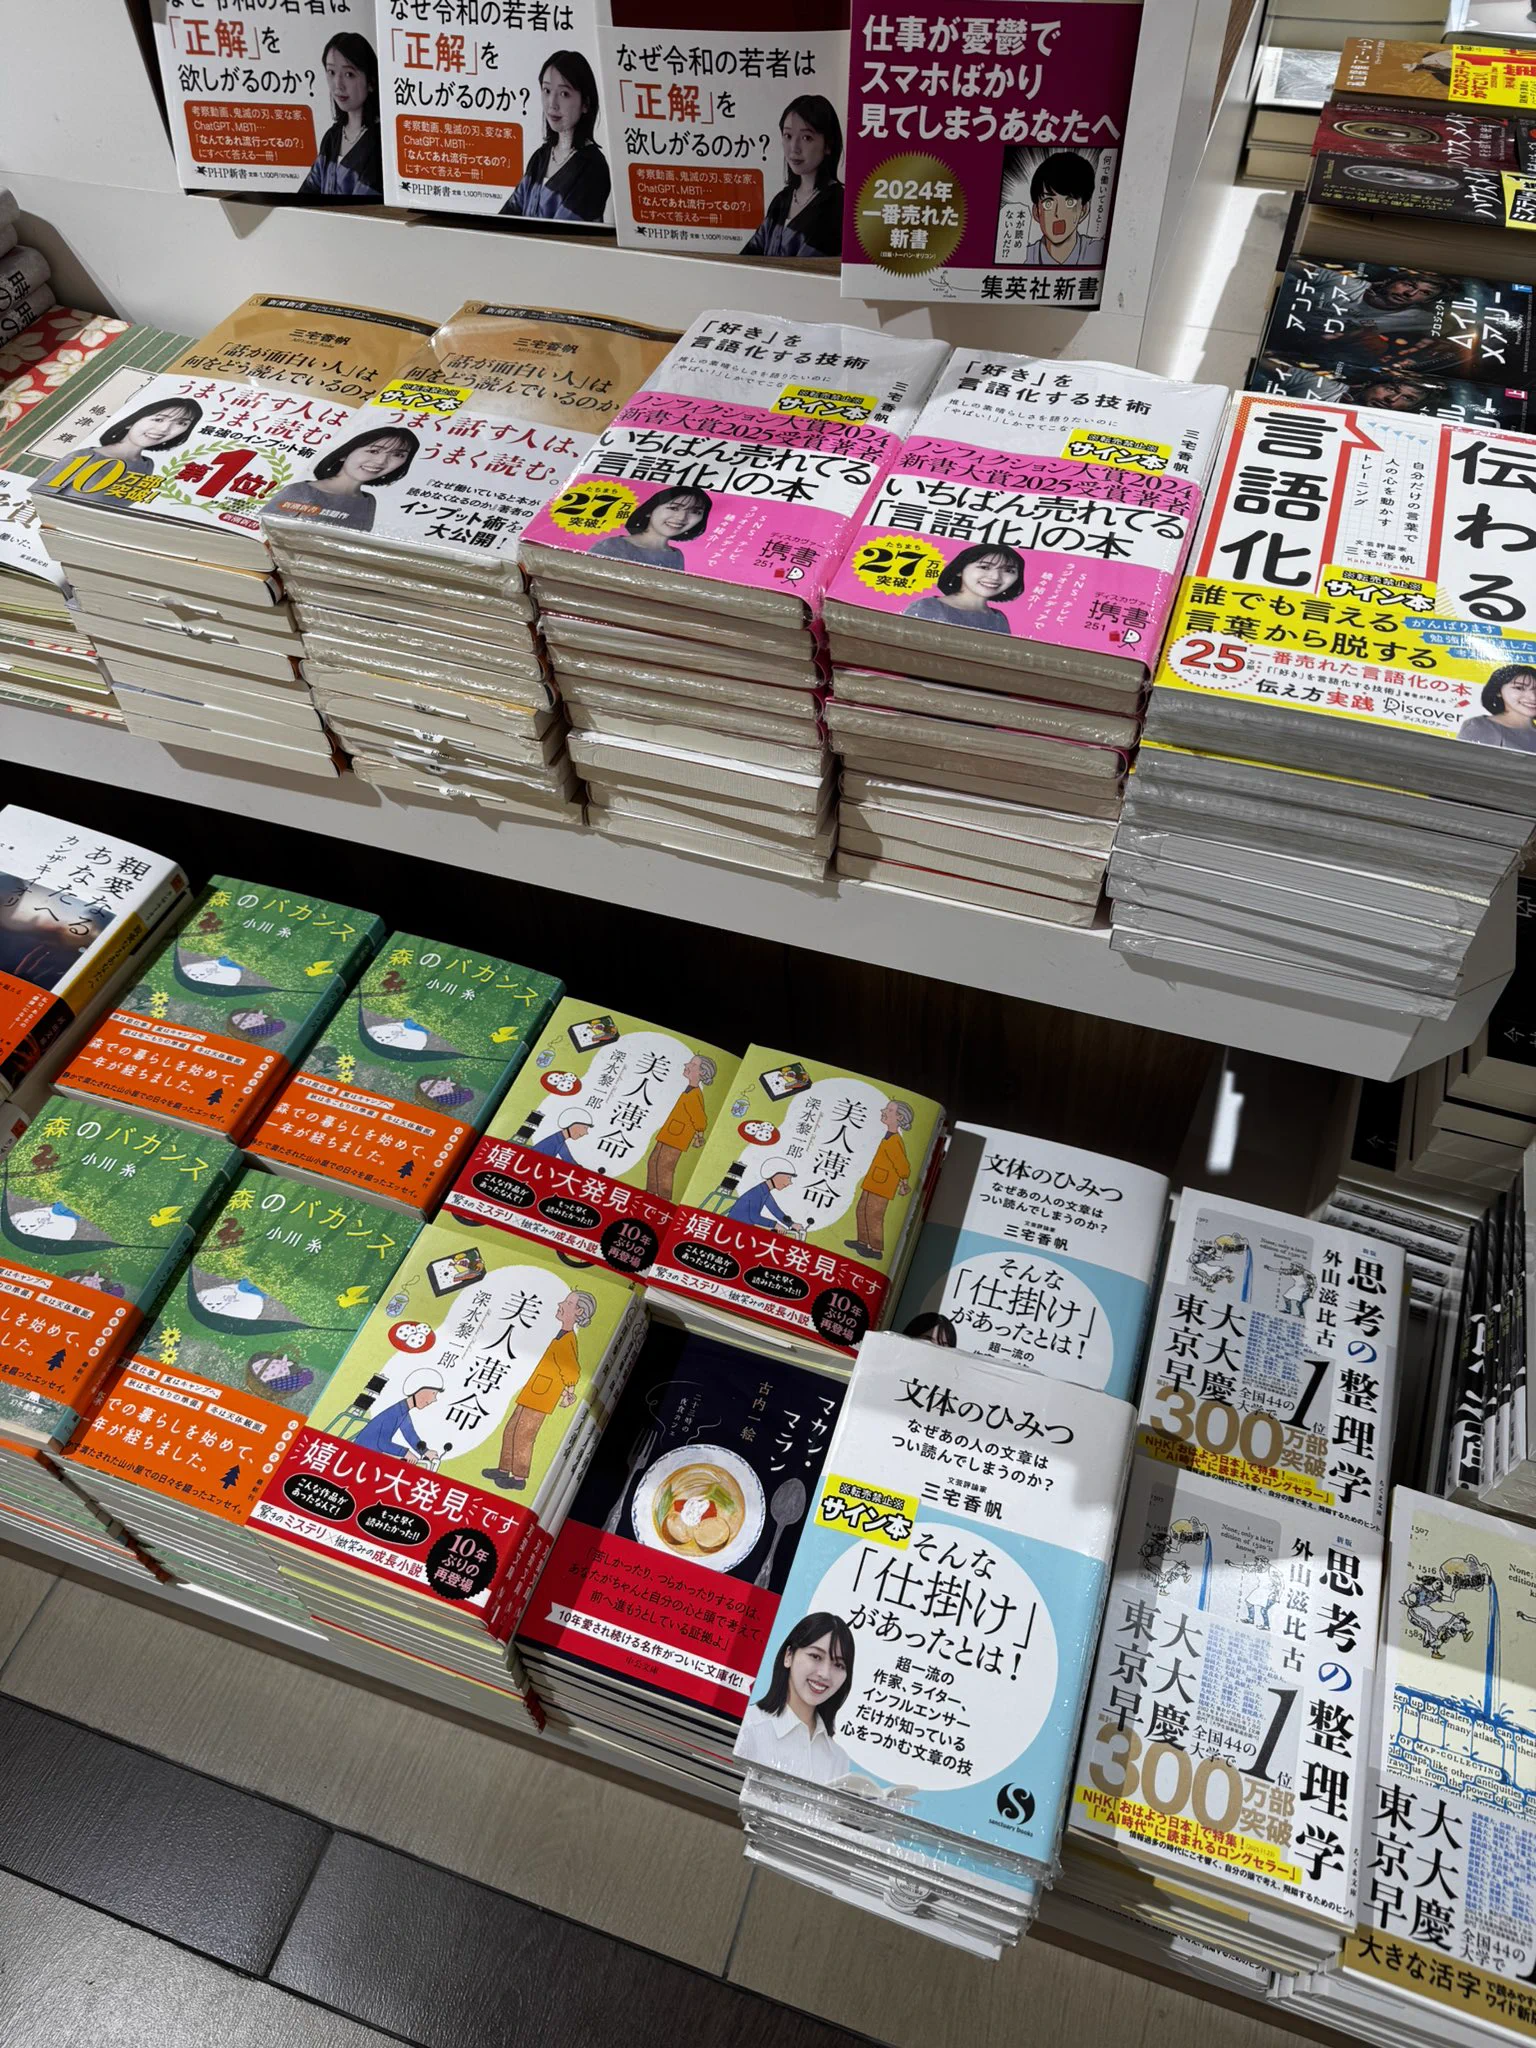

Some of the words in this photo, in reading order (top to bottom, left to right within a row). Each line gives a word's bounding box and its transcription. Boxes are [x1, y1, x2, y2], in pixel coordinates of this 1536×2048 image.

[169, 16, 280, 60] 「正解」を
[391, 28, 499, 75] 「正解」を
[863, 14, 1061, 57] 仕事が憂鬱で
[178, 64, 315, 97] 欲しがるのか?
[616, 44, 816, 78] なぜ令和の若者は
[861, 62, 1043, 100] スマホばかり
[619, 79, 736, 125] 「正解」を
[858, 103, 1121, 143] 見てしまうあなたへ
[873, 179, 953, 202] 2024年
[862, 204, 959, 226] 一番売れた
[1014, 211, 1026, 248] 本が読め
[890, 228, 929, 250] 新書
[981, 275, 1099, 301] 集英社新書
[1286, 268, 1319, 332] アンディ
[1324, 275, 1350, 333] ウィアー
[702, 320, 802, 347] 「好き」を
[1432, 298, 1446, 337] プロジェクト
[1480, 291, 1510, 365] メアリー
[216, 341, 379, 383] 「話が面白い人」は
[690, 336, 869, 370] 言語化する技術
[178, 380, 349, 427] うまく話す人は
[404, 365, 620, 412] 何をどう読んでいるのか
[957, 377, 1152, 416] 言語化する技術
[198, 425, 318, 459] 最強のインプット術
[207, 409, 331, 445] うまく読む
[386, 410, 579, 458] うまく話す人は、
[619, 407, 887, 463] 新書大賞2025受賞著者
[640, 395, 891, 449] ノンフィクション大賞2024
[41, 455, 127, 494] 10
[118, 471, 167, 489] 万部
[419, 443, 559, 486] うまく読む。
[579, 450, 820, 503] 「言語化」の本
[599, 430, 873, 486] いちばん売れてる
[104, 484, 161, 504] 突破!
[406, 487, 534, 518] 読めなくなるのか』著者の
[424, 479, 540, 506] 『なぜ働いていると本が
[585, 486, 619, 495] たちまち
[1219, 411, 1338, 586] 言語化
[1354, 454, 1372, 507] トレーニング
[1379, 458, 1400, 527] 人の心を動かす
[1404, 462, 1425, 543] 自分だけの言葉で
[399, 501, 523, 534] インプット術を
[554, 492, 624, 518] 27
[424, 524, 507, 549] 大公開!
[759, 539, 821, 568] 携書
[1451, 441, 1536, 623] 伝わる
[753, 558, 774, 568] 251
[1190, 583, 1399, 633] 誰でも言える
[1412, 620, 1495, 634] がんばります
[1180, 639, 1248, 673] 25
[1185, 610, 1438, 669] 言葉から脱する
[1182, 668, 1238, 682] ベストセラー
[1249, 647, 1472, 697] 一番売れた言語化の本
[1255, 678, 1375, 712] 伝え方実践
[1384, 697, 1464, 722] Discover
[7, 835, 80, 907] カンザキイオリ
[34, 847, 112, 923] あなたへ
[69, 856, 152, 936] 親愛なる
[208, 890, 356, 943] 森のバカンス
[389, 949, 539, 1008] 森のバカンス
[79, 1055, 195, 1096] 一年が経ちました。
[88, 1038, 236, 1087] 森での暮らしを始めて、
[42, 1116, 209, 1181] 森のバカンス
[273, 1102, 426, 1161] 森での暮らしを始めて、
[484, 1144, 674, 1227] 嬉しい大発見です
[983, 1154, 1124, 1202] 文体のひみつ
[227, 1188, 396, 1260] 森のバカンス
[1003, 1224, 1069, 1251] 三宅香帆
[999, 1258, 1064, 1290] そんな
[952, 1268, 1096, 1339] 「仕掛け」
[1315, 1248, 1343, 1350] 外山滋比古
[437, 1288, 492, 1370] 深水黎一郎
[951, 1306, 1087, 1360] があったとは!
[445, 1289, 544, 1432] 美人薄命
[739, 1381, 774, 1443] 古内一絵
[894, 1377, 1074, 1445] 文体のひみつ
[1279, 1358, 1331, 1431] 1
[770, 1409, 801, 1472] マラン
[907, 1418, 1048, 1470] なぜあの人の文章は
[1150, 1385, 1284, 1469] 300
[891, 1434, 1054, 1491] つい読んでしまうのか?
[1281, 1449, 1326, 1480] 突破
[291, 1487, 341, 1516] あったなんて!
[297, 1478, 349, 1506] こんな作品が
[921, 1481, 1004, 1520] 三宅香帆
[947, 1476, 988, 1494] 文芸評論家
[381, 1509, 415, 1528] もっと早く
[821, 1497, 913, 1541] サイン本
[1411, 1525, 1429, 1536] 1507
[442, 1555, 480, 1580] ぶりの
[449, 1533, 489, 1563] 10年
[912, 1533, 996, 1579] そんな
[433, 1567, 474, 1595] 再登場
[585, 1549, 761, 1621] 「苦しかったり、つらかったりするのは、
[568, 1562, 765, 1645] あなたがちゃんと自分の心と頭で考えて、
[590, 1590, 730, 1651] 前へ進もうとしている証拠よ」
[557, 1609, 743, 1690] 10年愛され続ける名作がついに文庫化!
[896, 1656, 955, 1687] 超一流の
[862, 1687, 971, 1730] インフルエンサー
[873, 1668, 969, 1713] 作家、ライター、
[856, 1704, 966, 1752] だけが知っている
[1295, 1547, 1363, 1882] 思考の整理学
[1404, 1705, 1419, 1719] has
[1420, 1710, 1444, 1727] made
[1446, 1720, 1471, 1737] many
[1507, 1740, 1516, 1751] in
[1411, 1697, 1424, 1711] up
[1426, 1702, 1438, 1716] by
[1439, 1707, 1473, 1728] dealers,
[1475, 1719, 1495, 1734] who
[1496, 1728, 1513, 1741] can
[840, 1720, 974, 1778] 心をつかむ文章の技
[1191, 1725, 1257, 1757] 全国44の
[1399, 1736, 1412, 1747] OF
[1415, 1741, 1502, 1778] MAP-COLLECTING
[1277, 1771, 1292, 1790] 位
[1411, 1766, 1422, 1776] us
[1424, 1768, 1447, 1783] from
[1449, 1776, 1463, 1790] the
[1465, 1783, 1493, 1802] power
[1432, 1760, 1449, 1774] like
[1450, 1765, 1474, 1782] other
[1358, 1935, 1481, 1999] 大きな活字
[1459, 1945, 1506, 1972] 大学で
